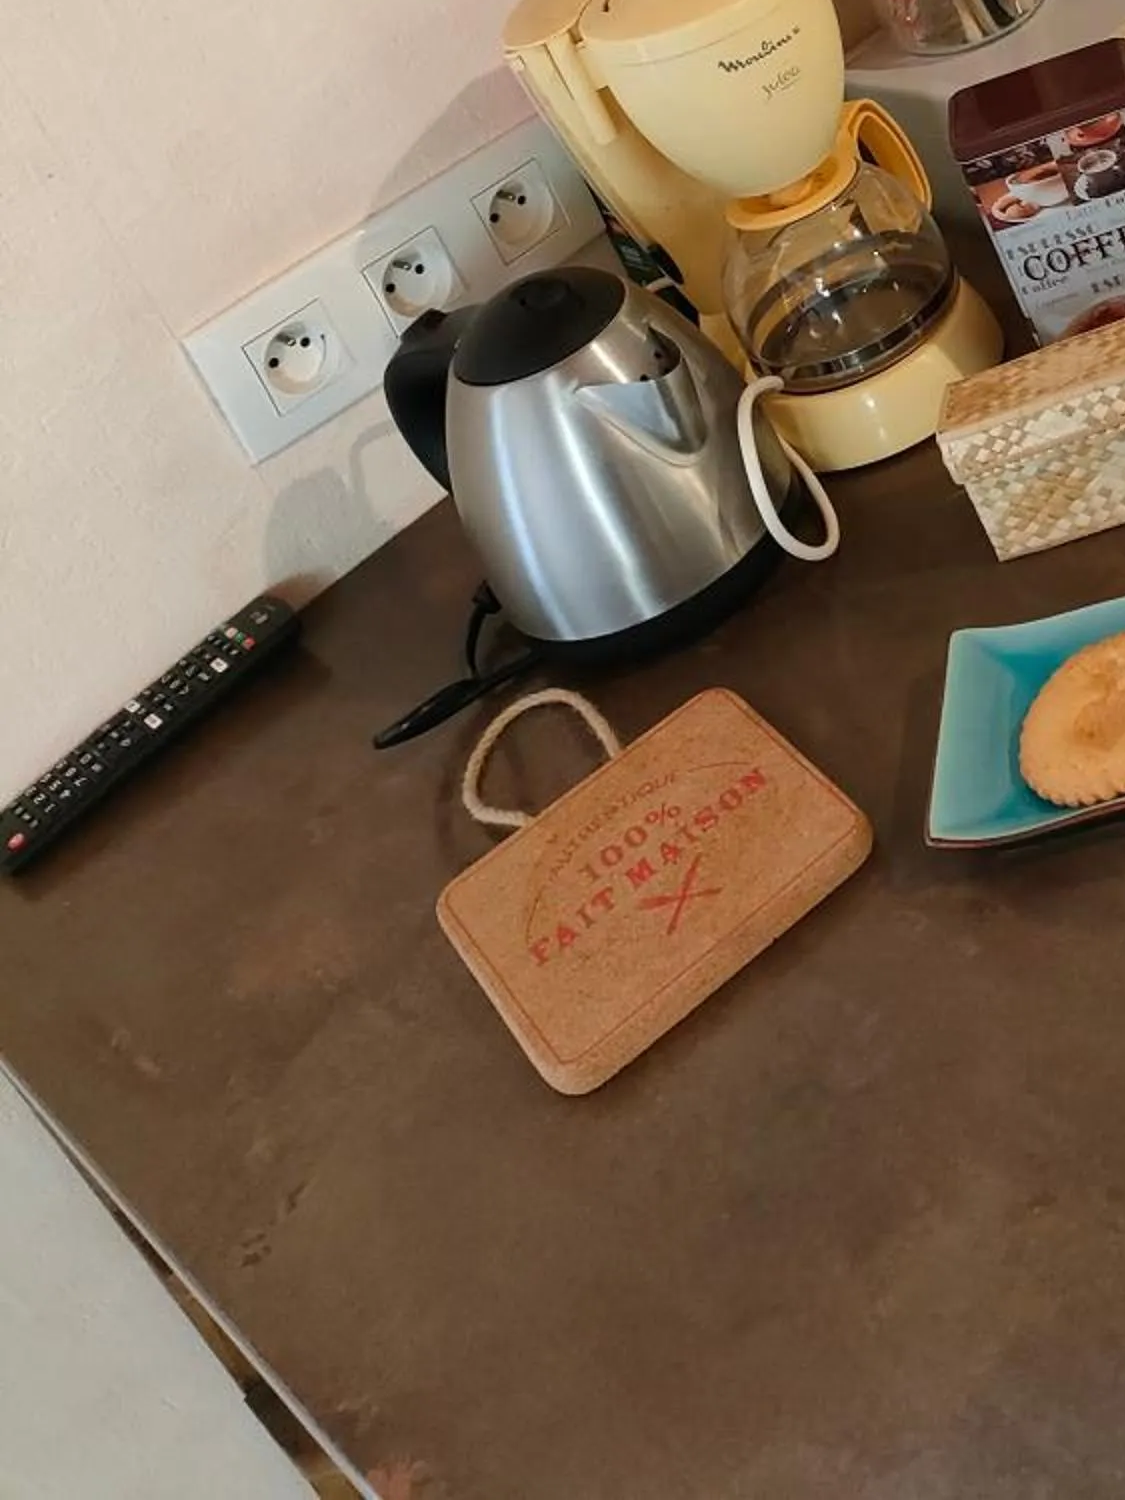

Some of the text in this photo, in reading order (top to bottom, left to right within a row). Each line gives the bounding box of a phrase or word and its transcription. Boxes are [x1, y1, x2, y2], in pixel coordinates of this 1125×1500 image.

[528, 766, 767, 969] FAIT MAISON
[576, 802, 683, 886] 100%
